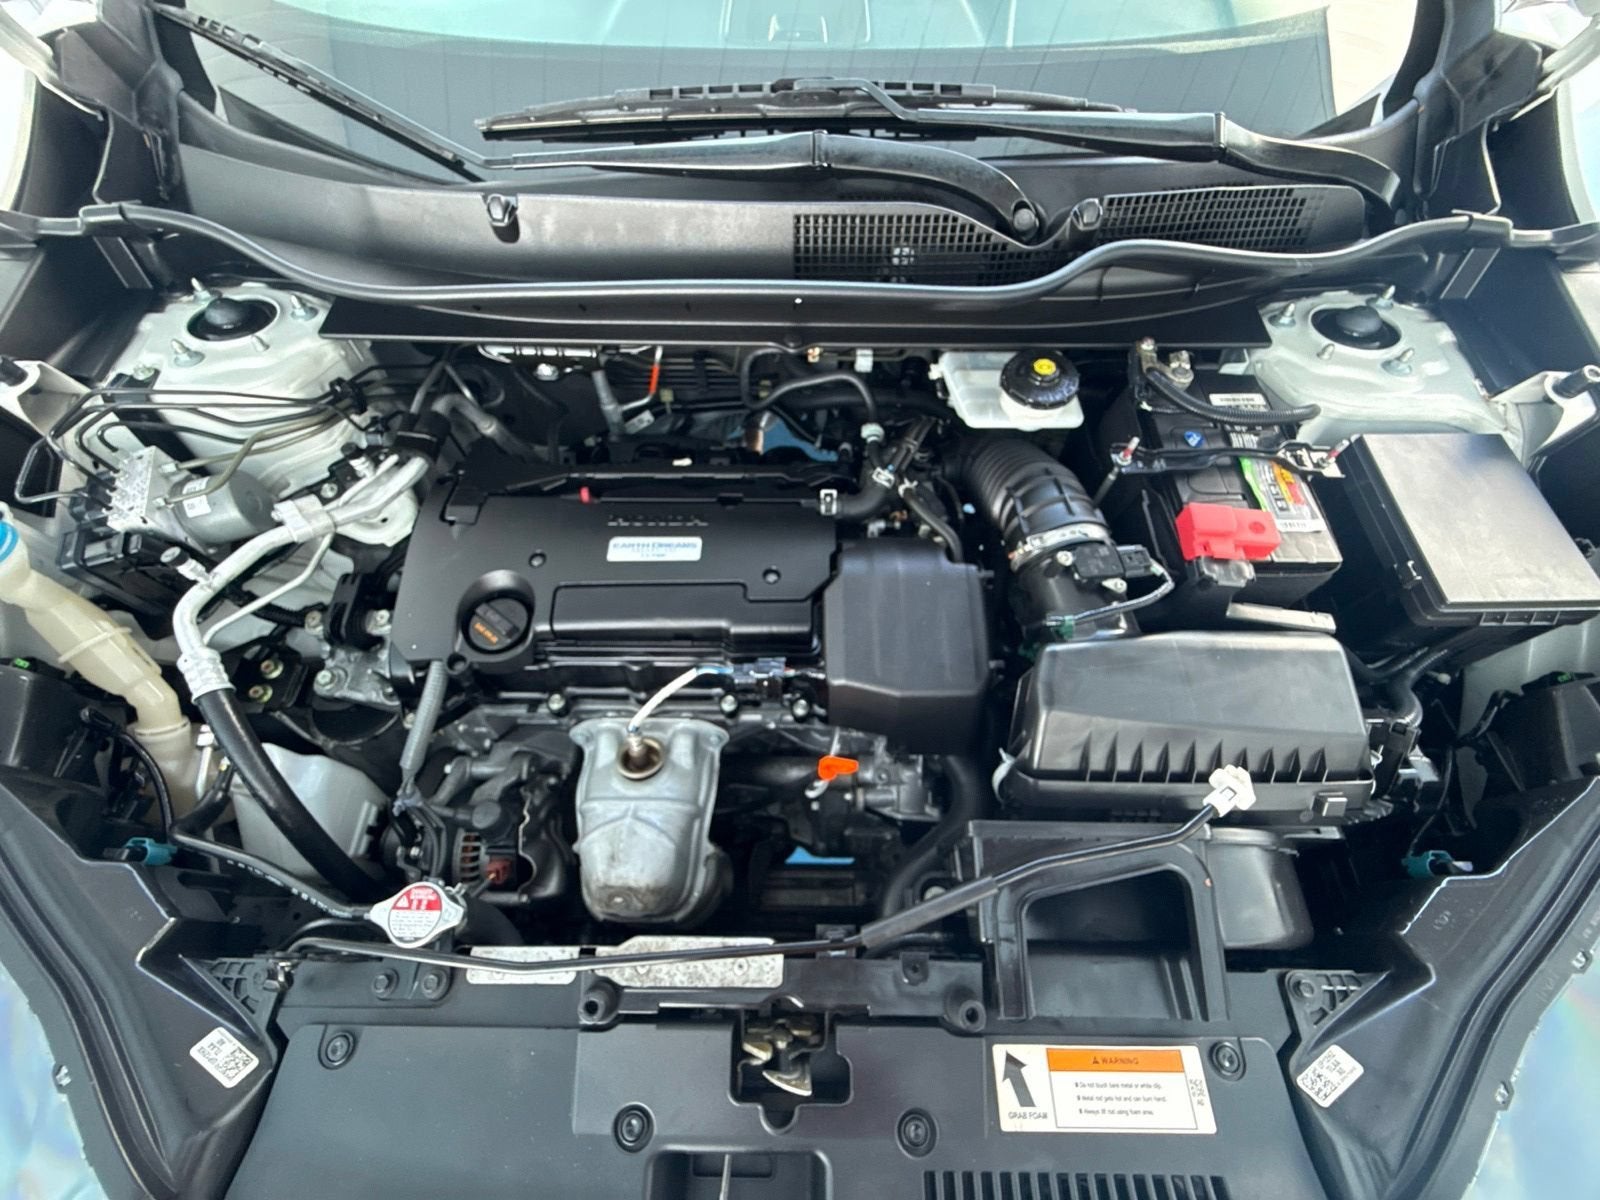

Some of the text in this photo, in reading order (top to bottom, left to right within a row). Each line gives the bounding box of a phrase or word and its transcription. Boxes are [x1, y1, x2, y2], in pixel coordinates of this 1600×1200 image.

[1101, 1056, 1139, 1065] WARNING
[1008, 1111, 1048, 1120] GRAB FOAM
